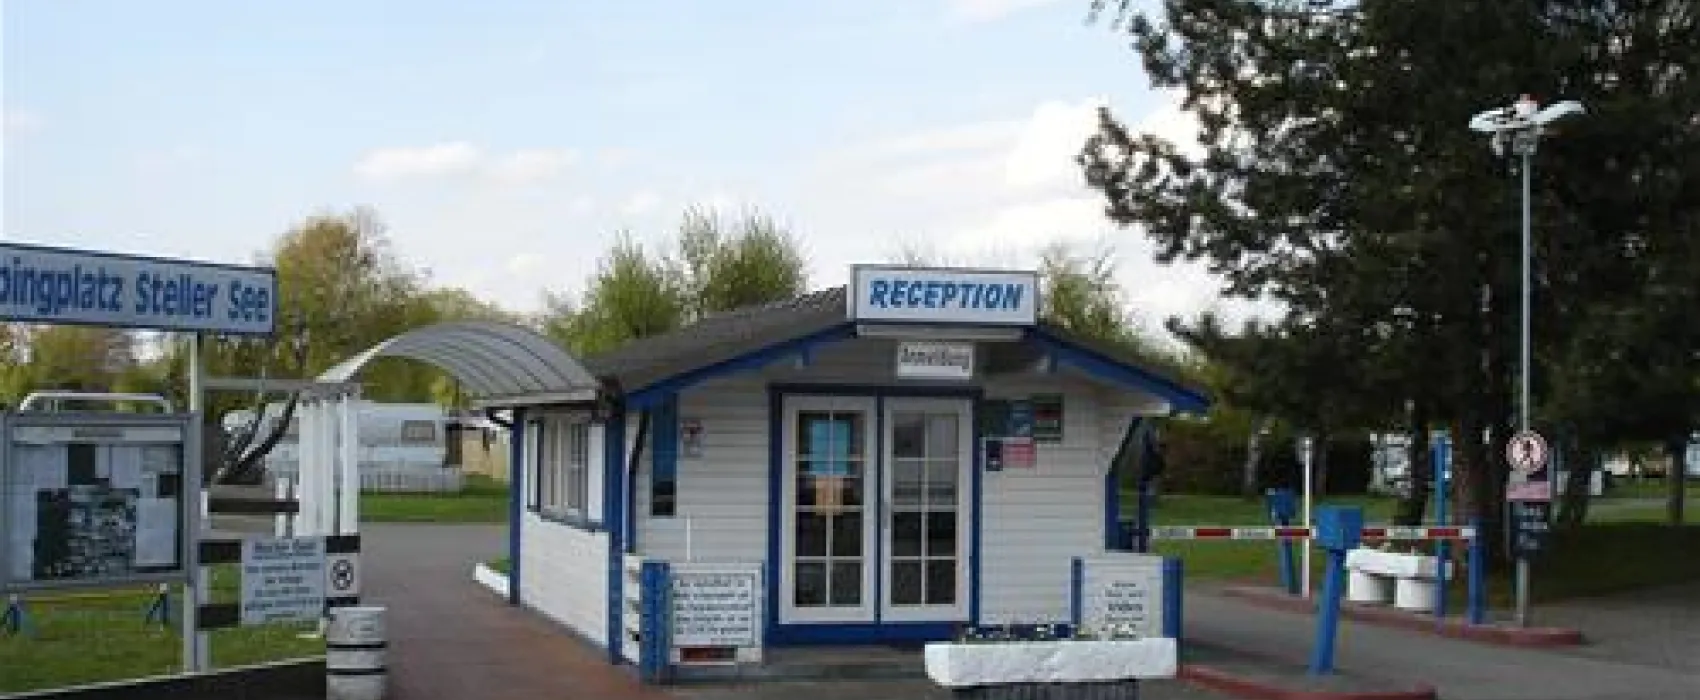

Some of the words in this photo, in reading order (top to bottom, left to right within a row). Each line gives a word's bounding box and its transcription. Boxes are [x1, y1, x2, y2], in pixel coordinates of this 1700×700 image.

[135, 271, 218, 319] Steller
[228, 279, 270, 322] See
[869, 280, 1024, 311] RECEPTION
